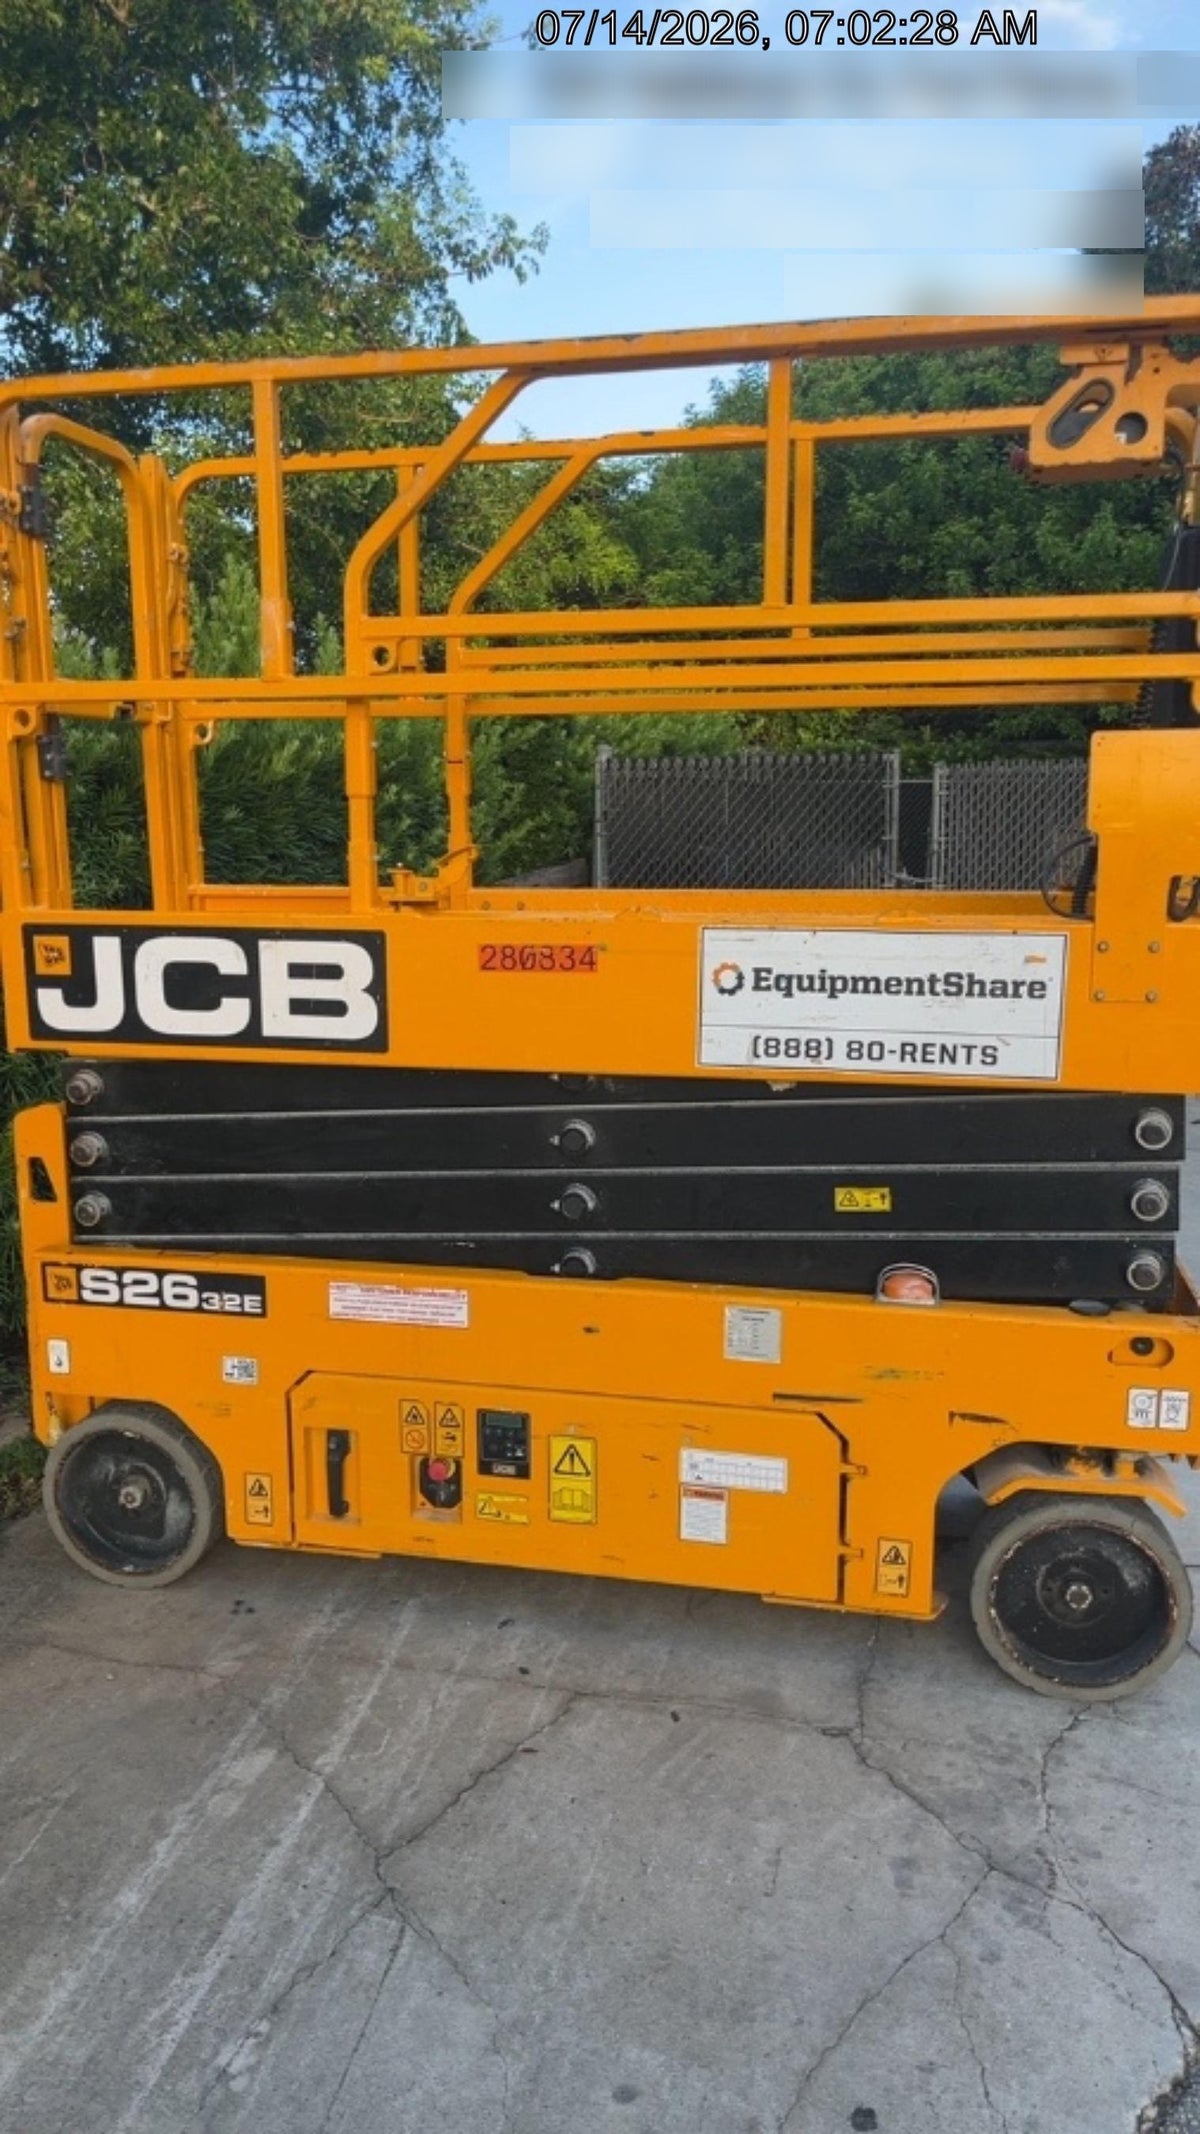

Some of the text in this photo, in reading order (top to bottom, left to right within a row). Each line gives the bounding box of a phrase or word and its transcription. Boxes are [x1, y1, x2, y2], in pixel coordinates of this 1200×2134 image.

[37, 936, 379, 1041] JCB
[752, 967, 1047, 999] EquipmentShare
[753, 1035, 999, 1066] (888) 80-RENTS
